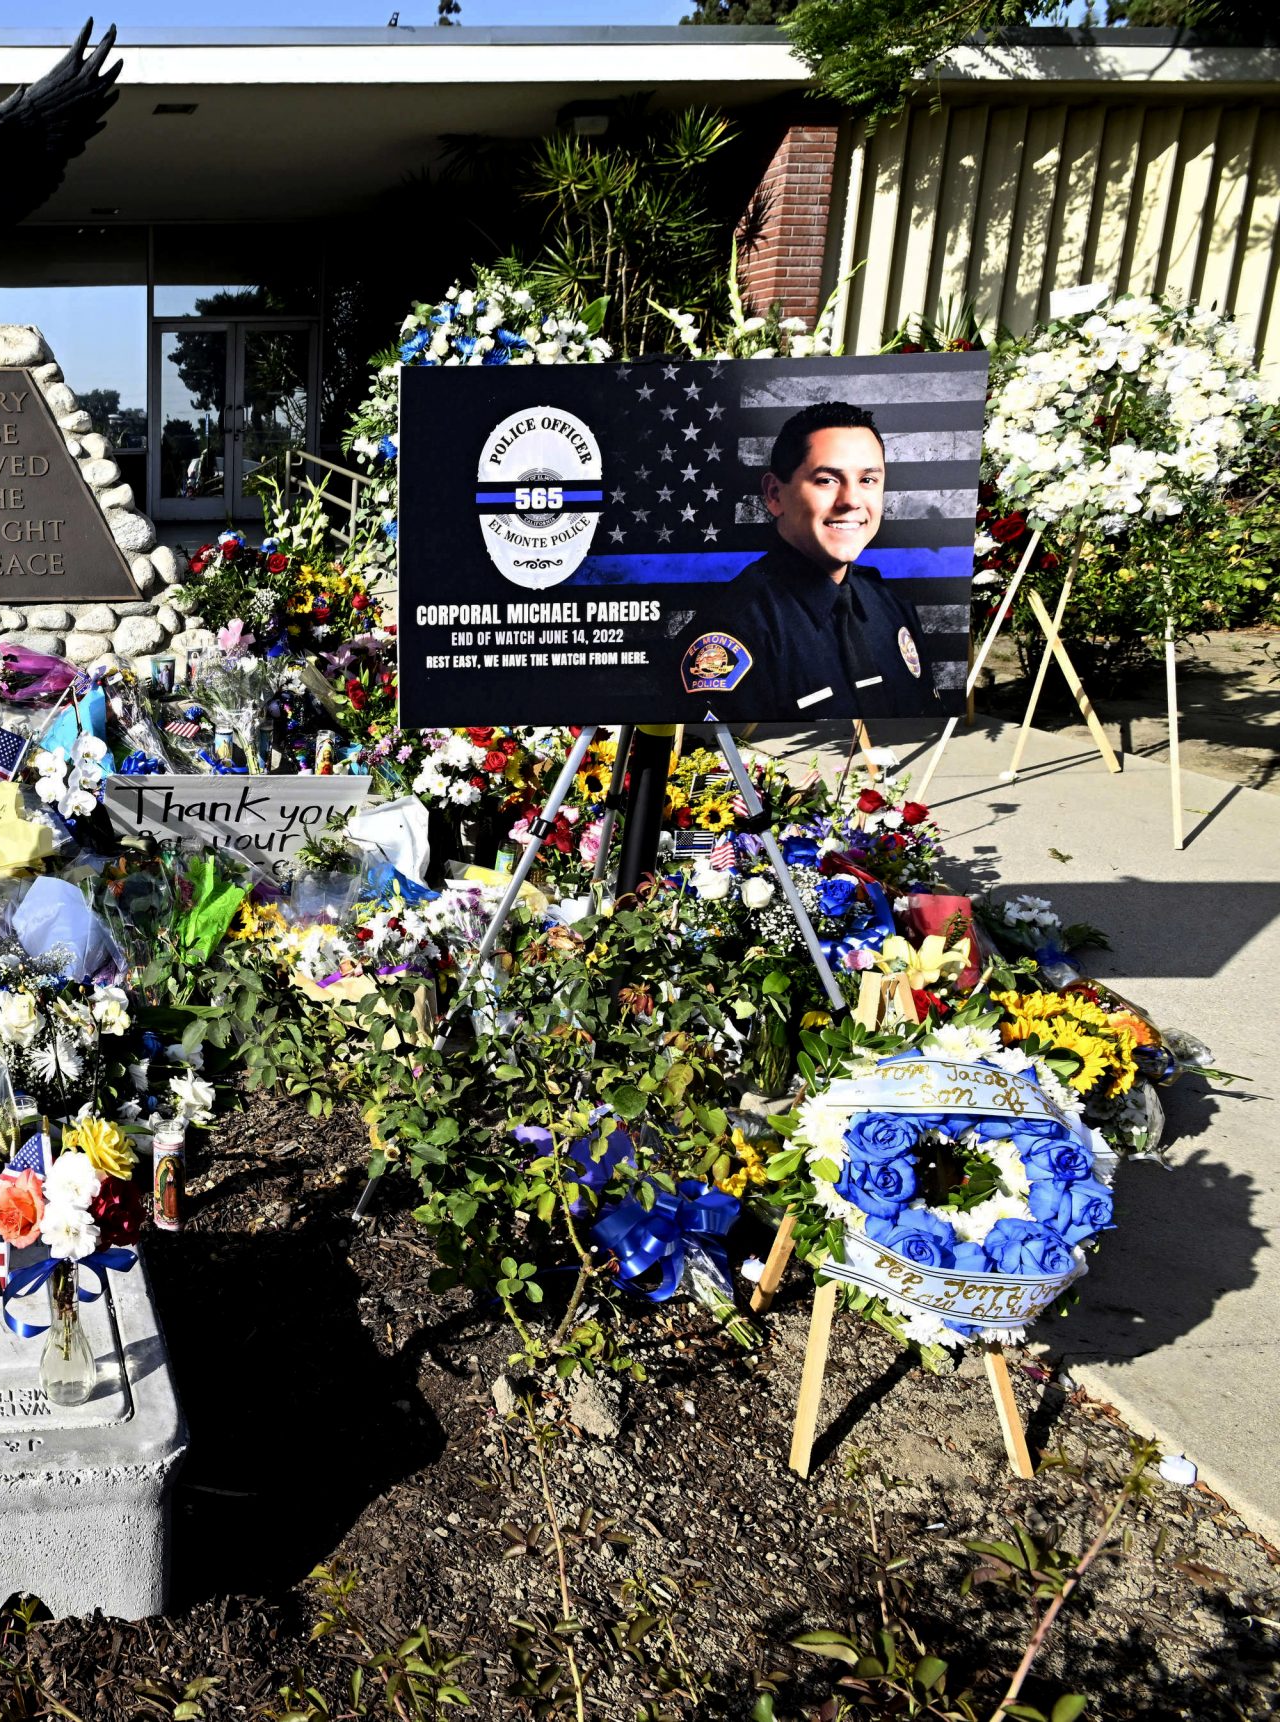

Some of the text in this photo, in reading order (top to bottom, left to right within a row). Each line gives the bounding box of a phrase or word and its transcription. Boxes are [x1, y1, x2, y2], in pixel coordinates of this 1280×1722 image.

[489, 416, 592, 466] POLICE OFFICER
[515, 487, 563, 510] 565
[488, 516, 591, 548] EL MONTE POLICE
[416, 600, 661, 626] CORPORAL MICHAEL PAREDES
[451, 628, 624, 646] END OF WATCH JUNE 14, 2022
[702, 635, 742, 655] MONTE
[426, 651, 650, 669] REST EASY, WE HAVE THE WATCH FROM HERE.
[692, 679, 727, 688] POLICE
[114, 786, 355, 832] Thank you
[941, 1063, 1009, 1089] Jacob
